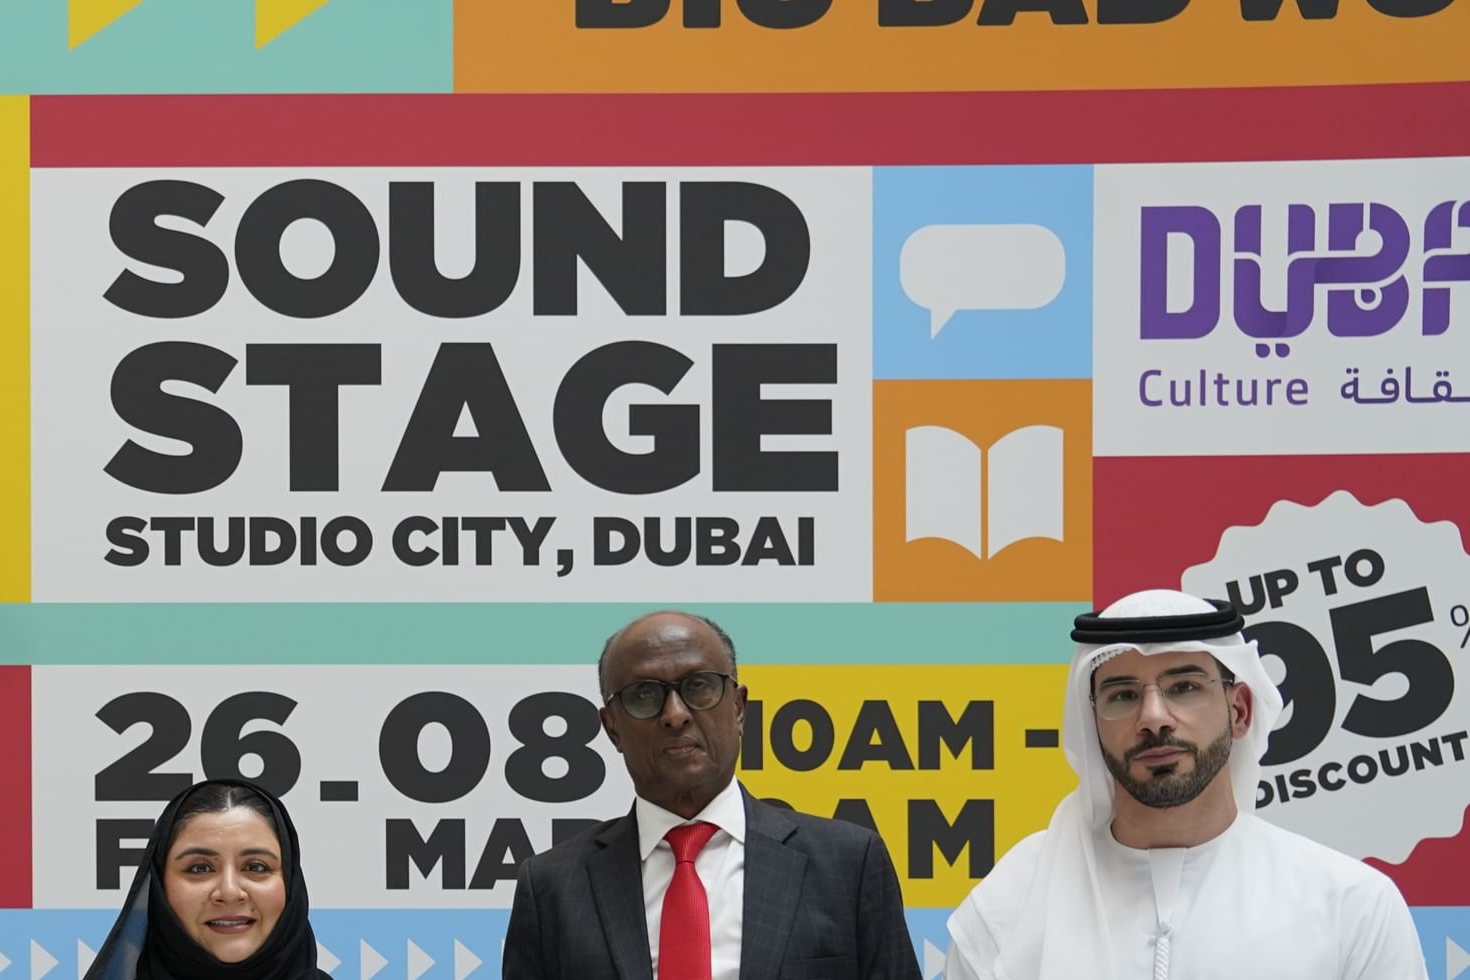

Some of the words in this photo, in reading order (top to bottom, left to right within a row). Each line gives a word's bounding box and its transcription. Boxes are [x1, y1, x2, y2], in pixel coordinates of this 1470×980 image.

[103, 179, 810, 319] SOUND
[103, 340, 838, 495] STAGE
[1139, 369, 1308, 406] Culture
[1341, 366, 1470, 404] قافة
[104, 516, 373, 567] STUDIO
[392, 515, 574, 577] CITY,
[594, 516, 815, 567] DUBAI
[1226, 569, 1299, 615] UP
[1307, 549, 1385, 596] TO
[94, 691, 301, 802] 26
[378, 691, 606, 803] 08
[1255, 731, 1469, 809] DISCOUNT
[385, 818, 602, 890] MA
